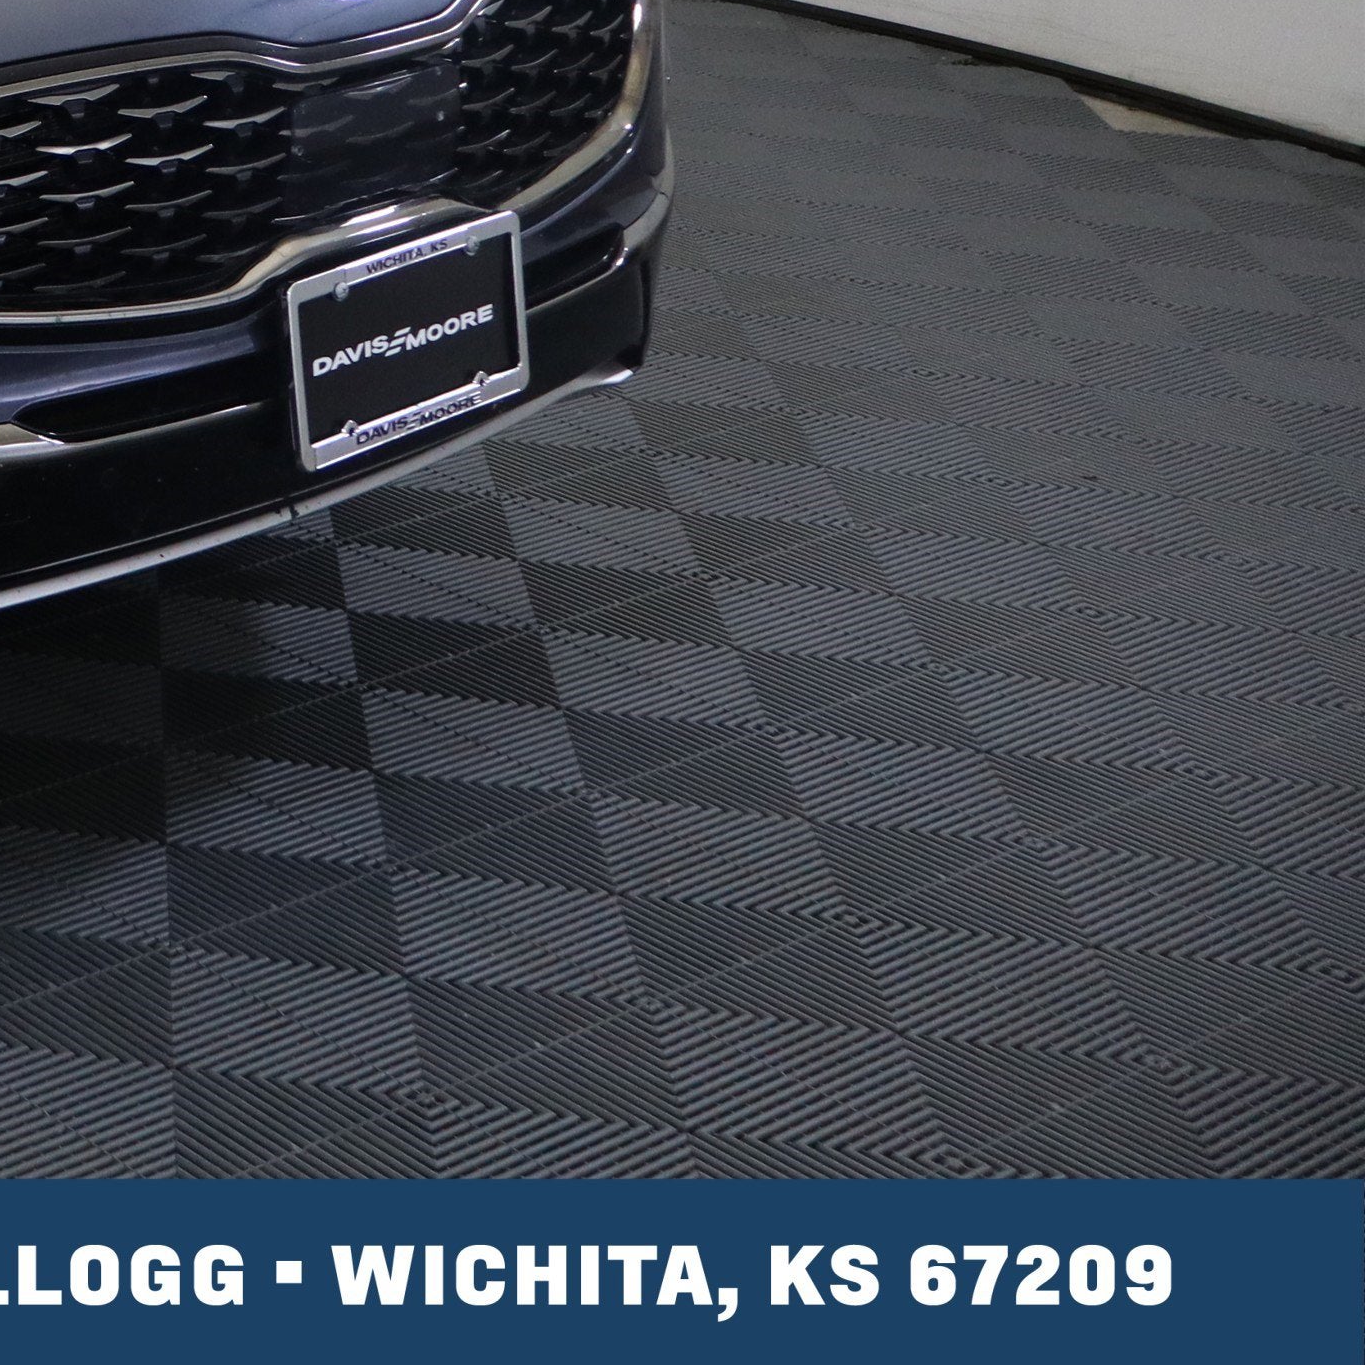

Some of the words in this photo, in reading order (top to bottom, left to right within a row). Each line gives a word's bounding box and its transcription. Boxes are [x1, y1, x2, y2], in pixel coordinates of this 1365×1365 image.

[430, 238, 448, 252] KS
[312, 333, 388, 377] DAVIS
[405, 303, 494, 351] MOORE
